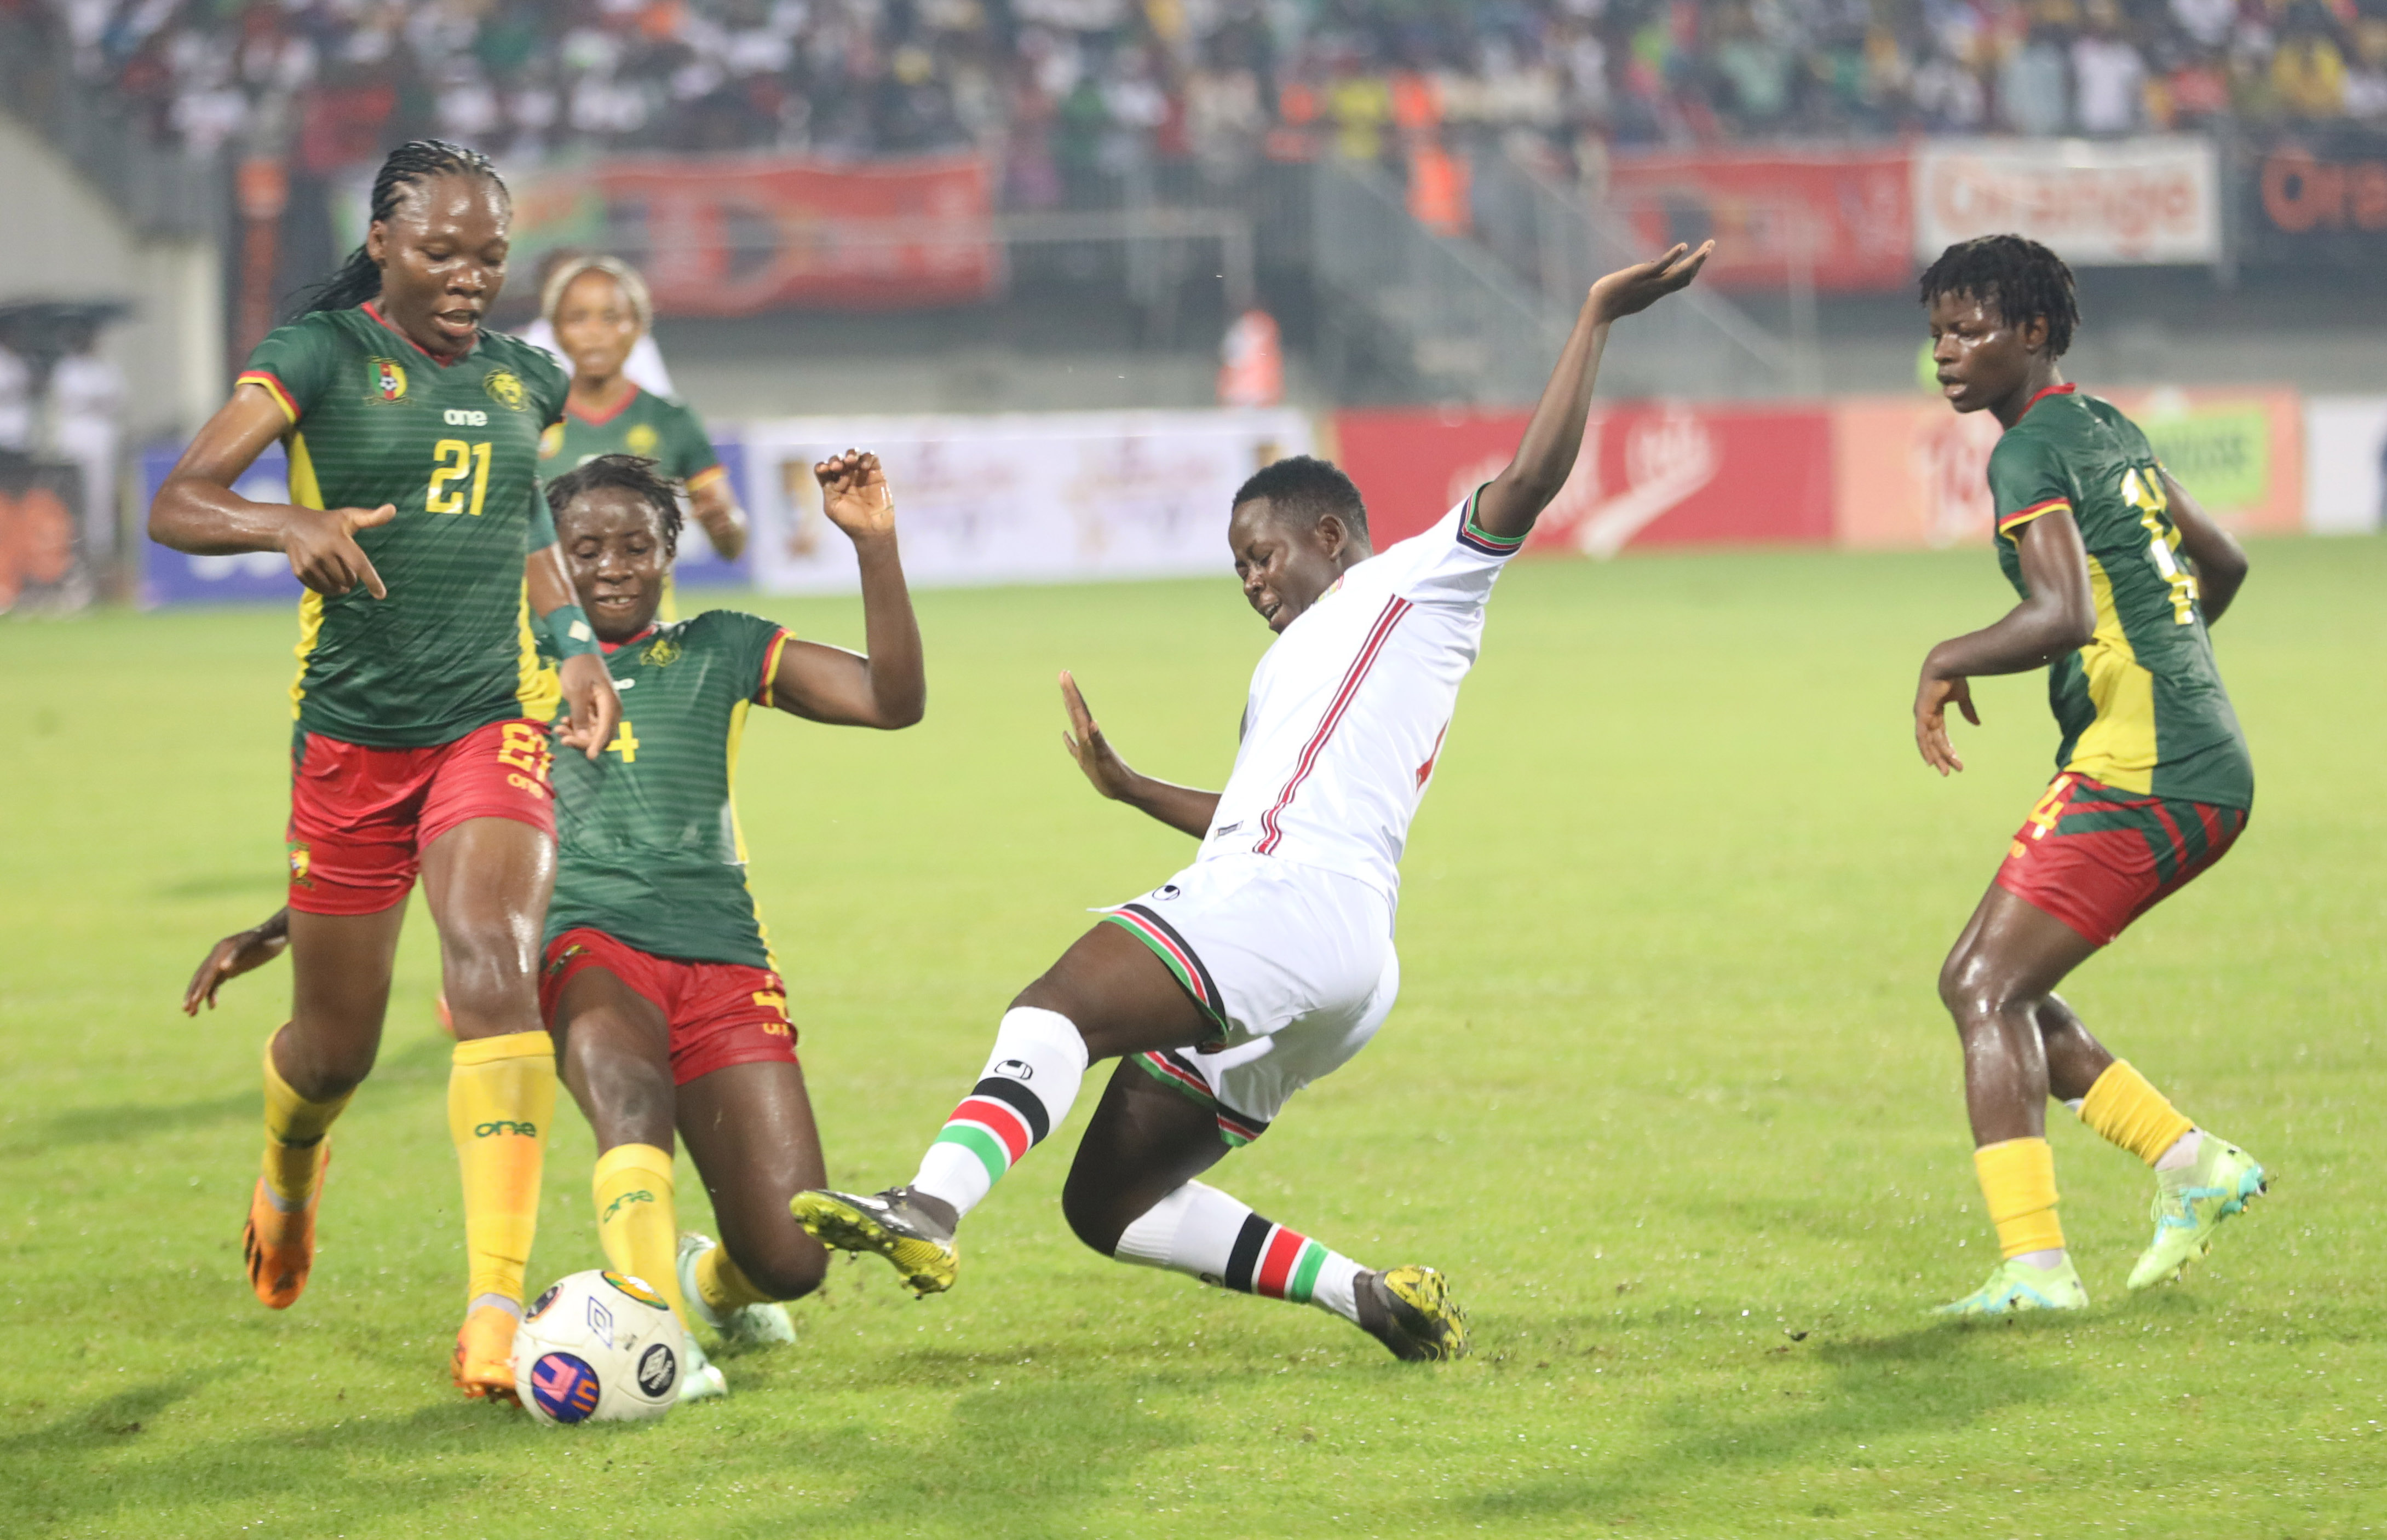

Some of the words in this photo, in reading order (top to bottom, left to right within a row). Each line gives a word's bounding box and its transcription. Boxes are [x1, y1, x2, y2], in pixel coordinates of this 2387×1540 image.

[444, 409, 488, 427] one
[425, 439, 492, 516] 21
[605, 721, 640, 763] 4
[475, 1121, 536, 1137] one
[603, 1190, 655, 1224] one
